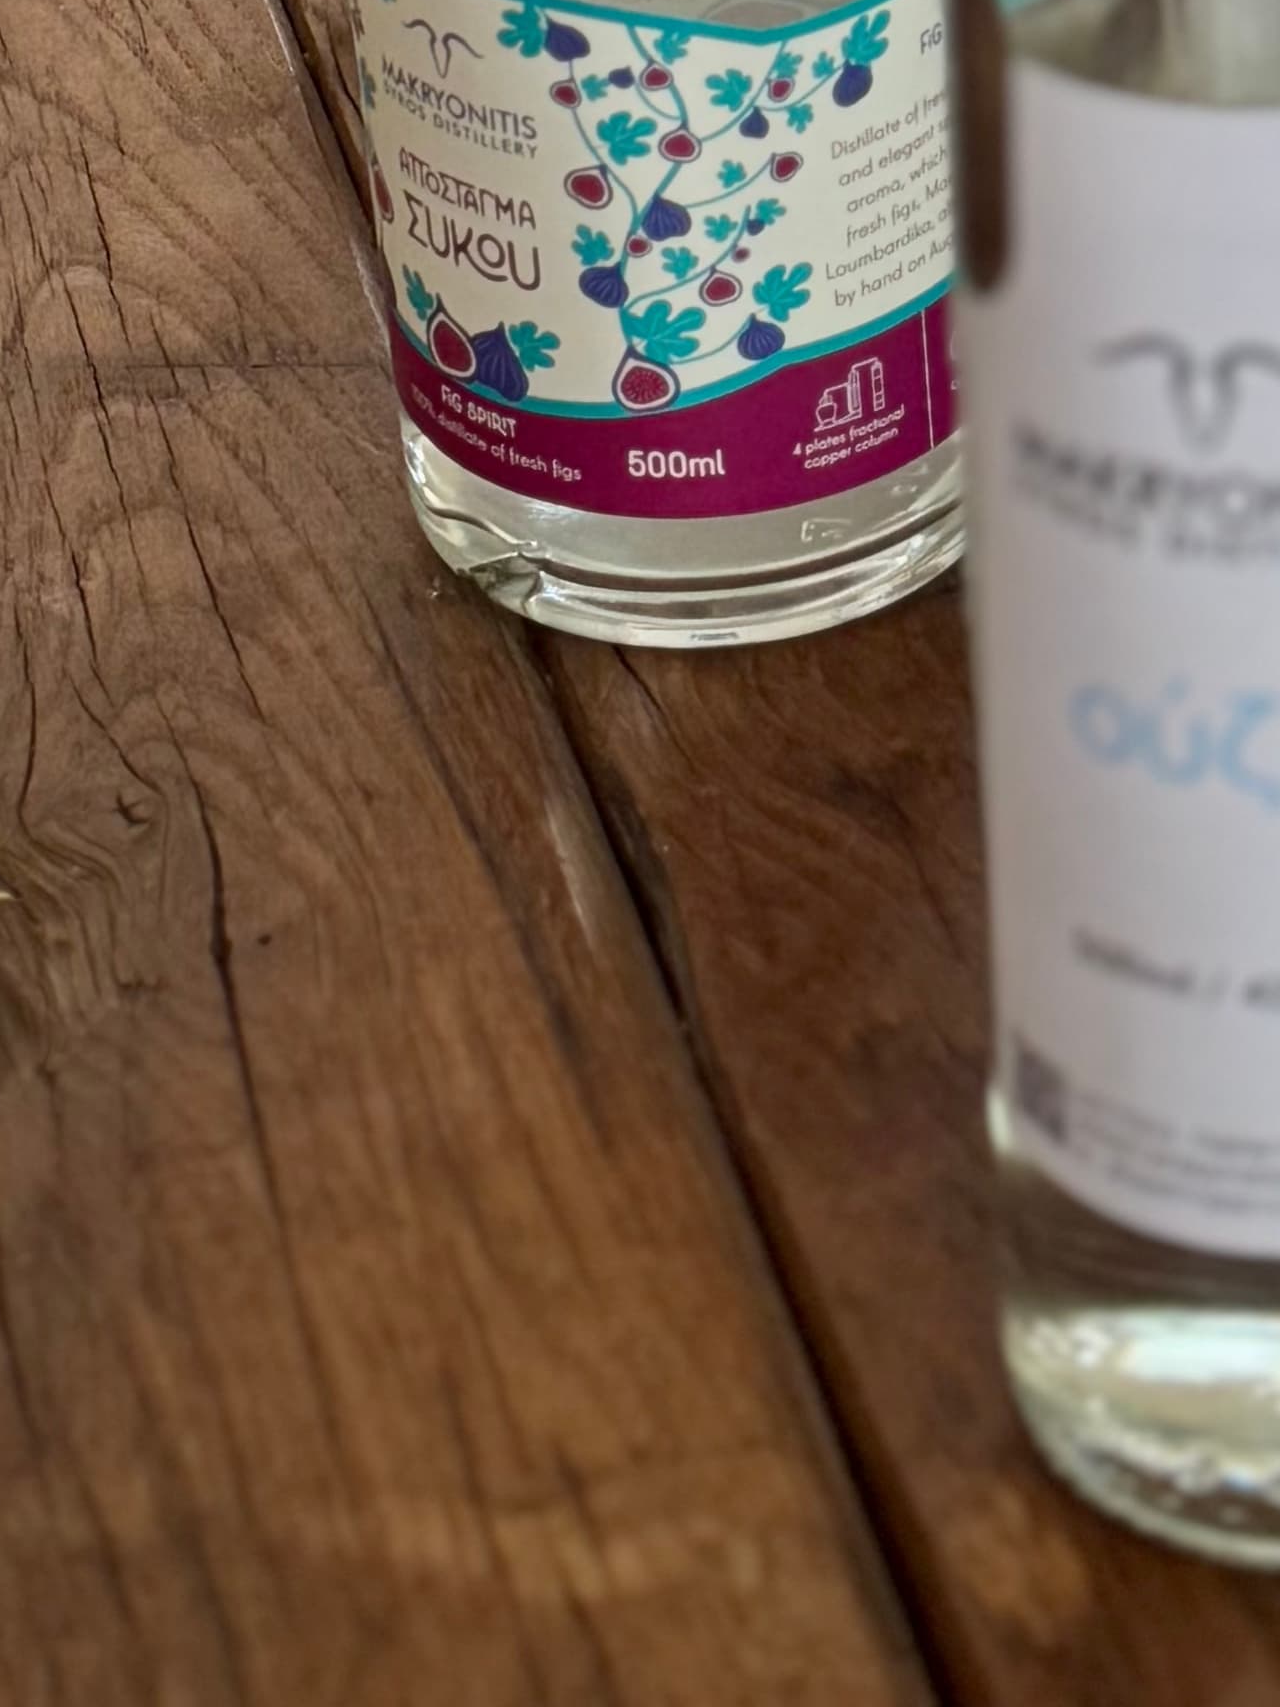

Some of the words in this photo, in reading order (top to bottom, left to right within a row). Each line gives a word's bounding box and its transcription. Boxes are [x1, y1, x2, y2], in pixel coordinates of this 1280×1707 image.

[381, 53, 538, 141] MAKRYONITIS
[432, 111, 538, 161] DISTILLERY
[831, 118, 901, 160] Distillate
[904, 100, 919, 126] of
[838, 156, 873, 187] and
[878, 124, 935, 169] elegant
[846, 178, 905, 213] aroma,
[909, 144, 947, 183] which
[846, 211, 887, 248] fresh
[834, 288, 856, 308] by
[860, 260, 903, 297] hand
[907, 253, 926, 273] on
[467, 401, 517, 439] SPIRIT
[791, 442, 802, 456] 4
[805, 431, 847, 457] plates
[849, 402, 906, 443] fractional
[490, 443, 505, 463] of
[508, 448, 548, 473] fresh
[551, 458, 583, 482] figs
[627, 448, 727, 479] 500ml
[803, 446, 852, 470] copper
[854, 426, 900, 454] column
